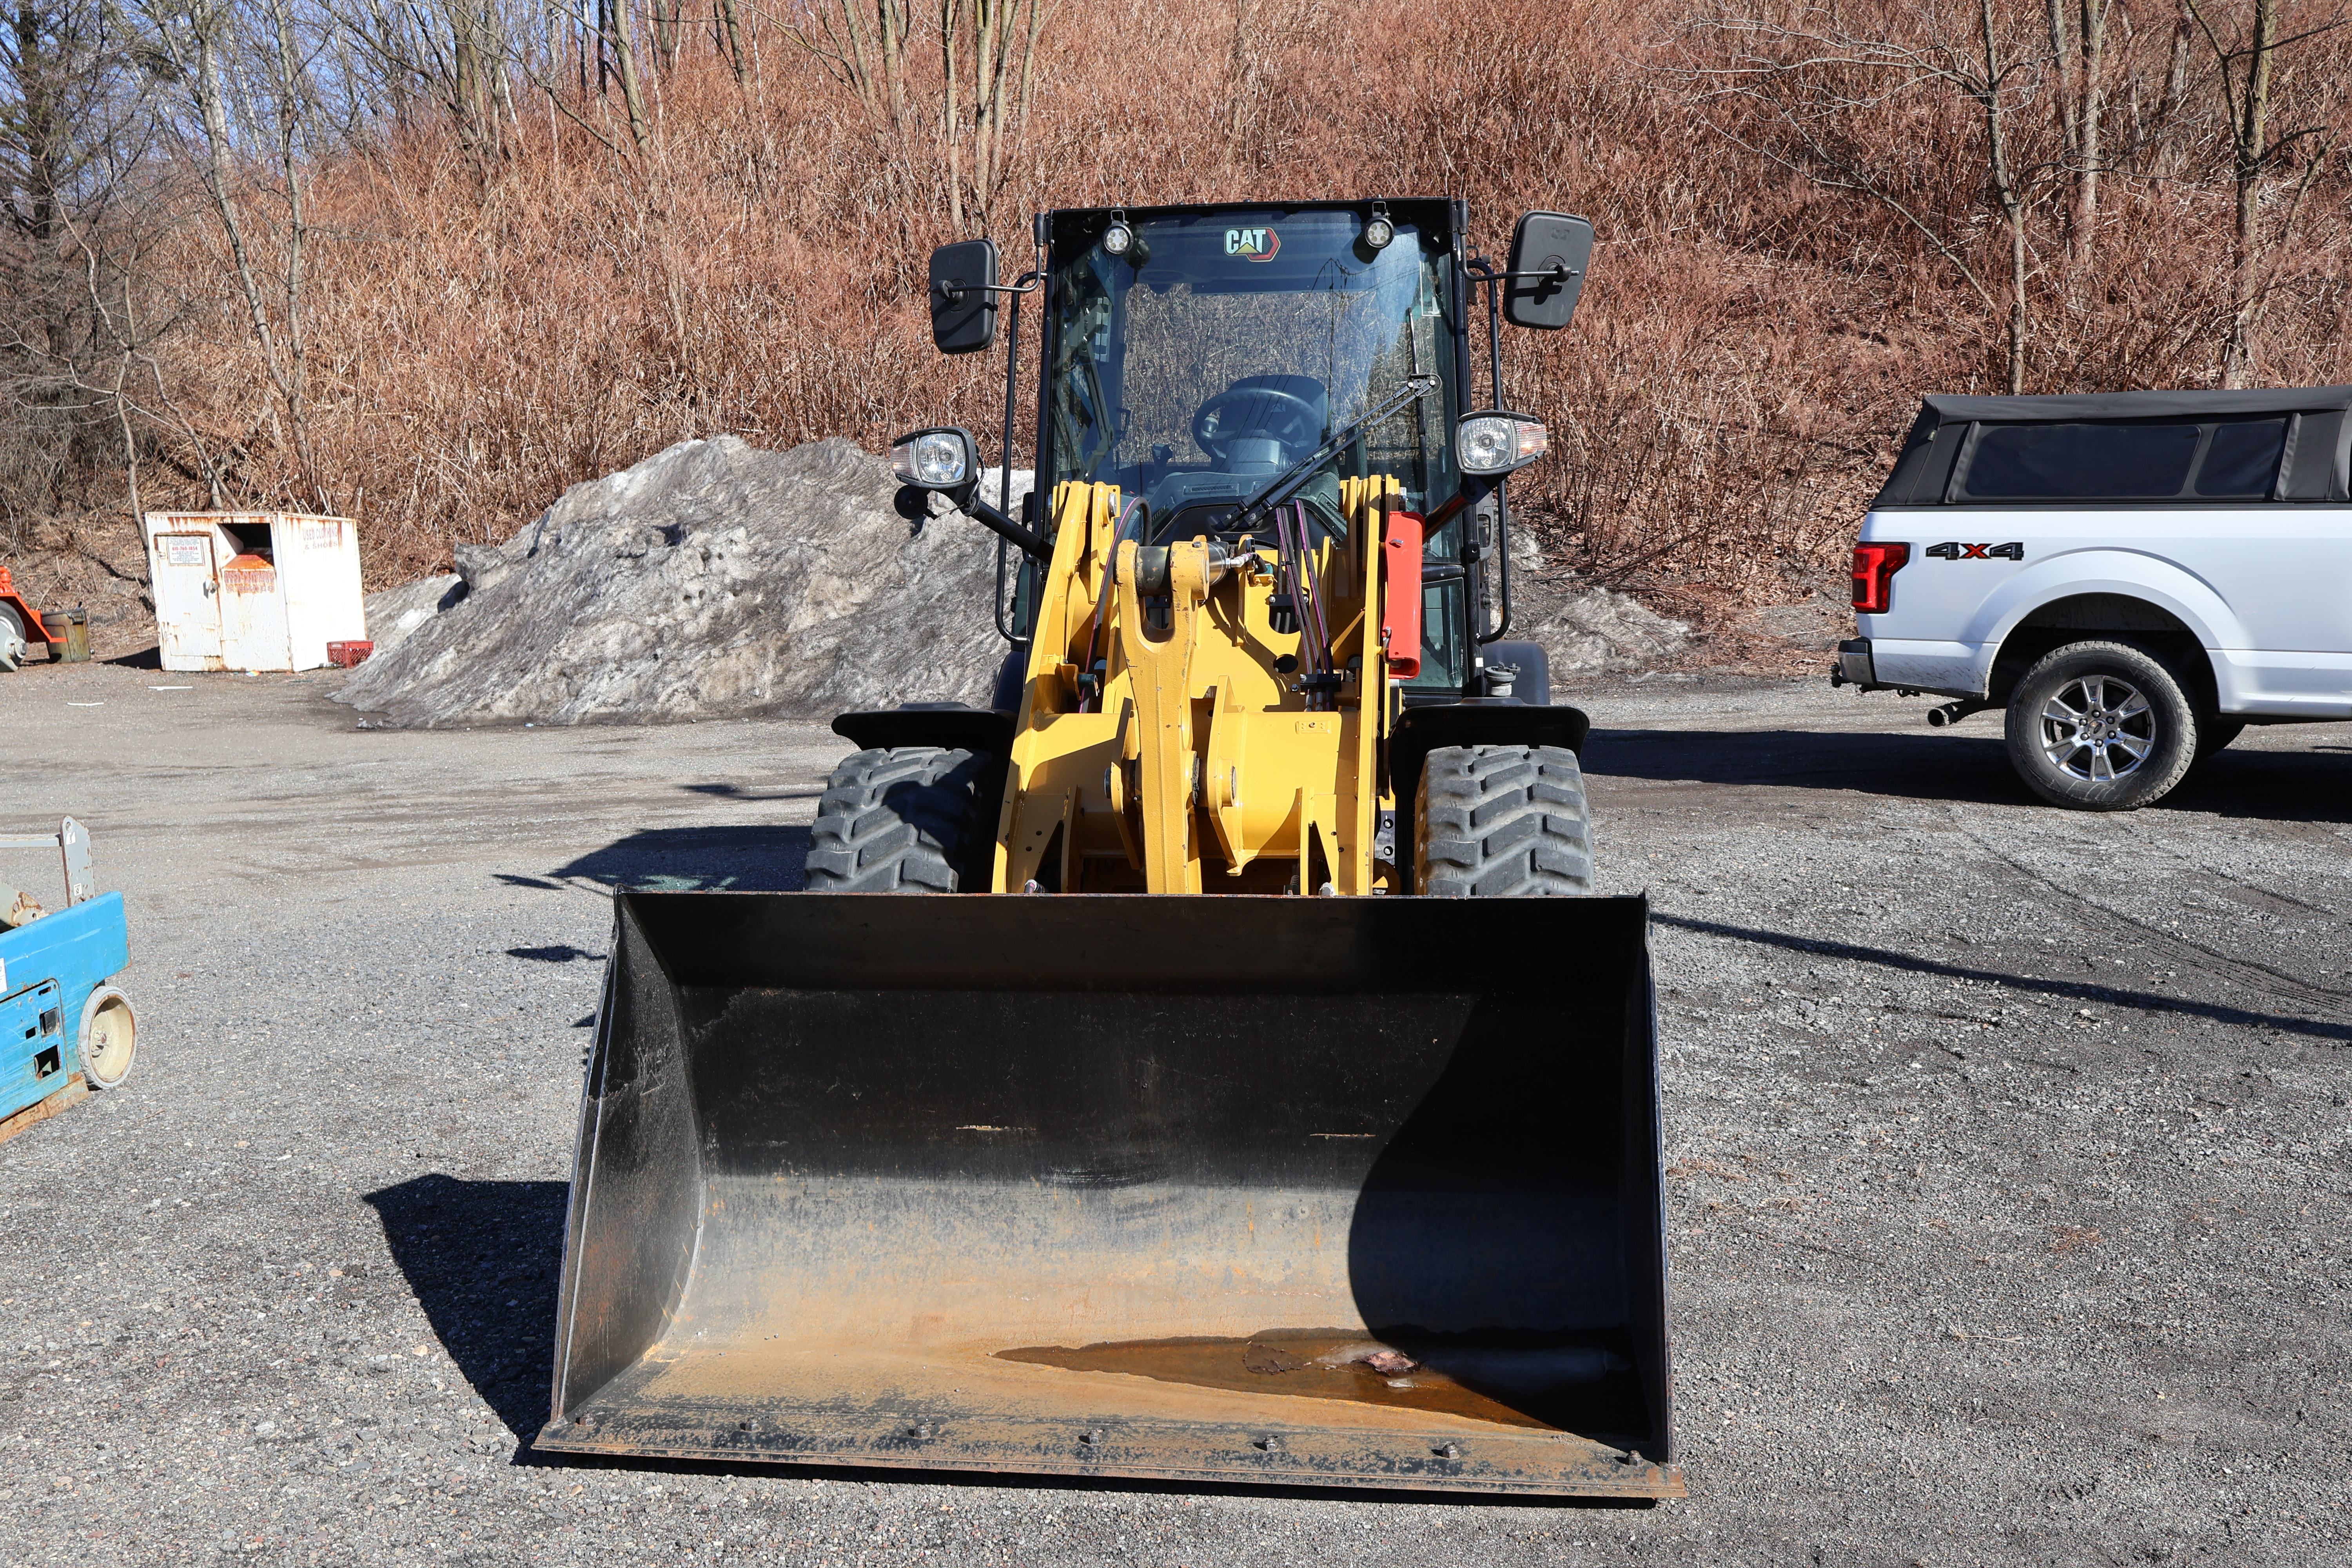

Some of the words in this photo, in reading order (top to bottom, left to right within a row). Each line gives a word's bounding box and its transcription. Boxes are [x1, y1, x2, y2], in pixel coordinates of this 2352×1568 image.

[1226, 229, 1266, 254] CAT
[303, 528, 315, 541] USED
[316, 526, 338, 539] CLOTHING
[225, 571, 241, 583] USED
[243, 570, 274, 583] CLOTHING
